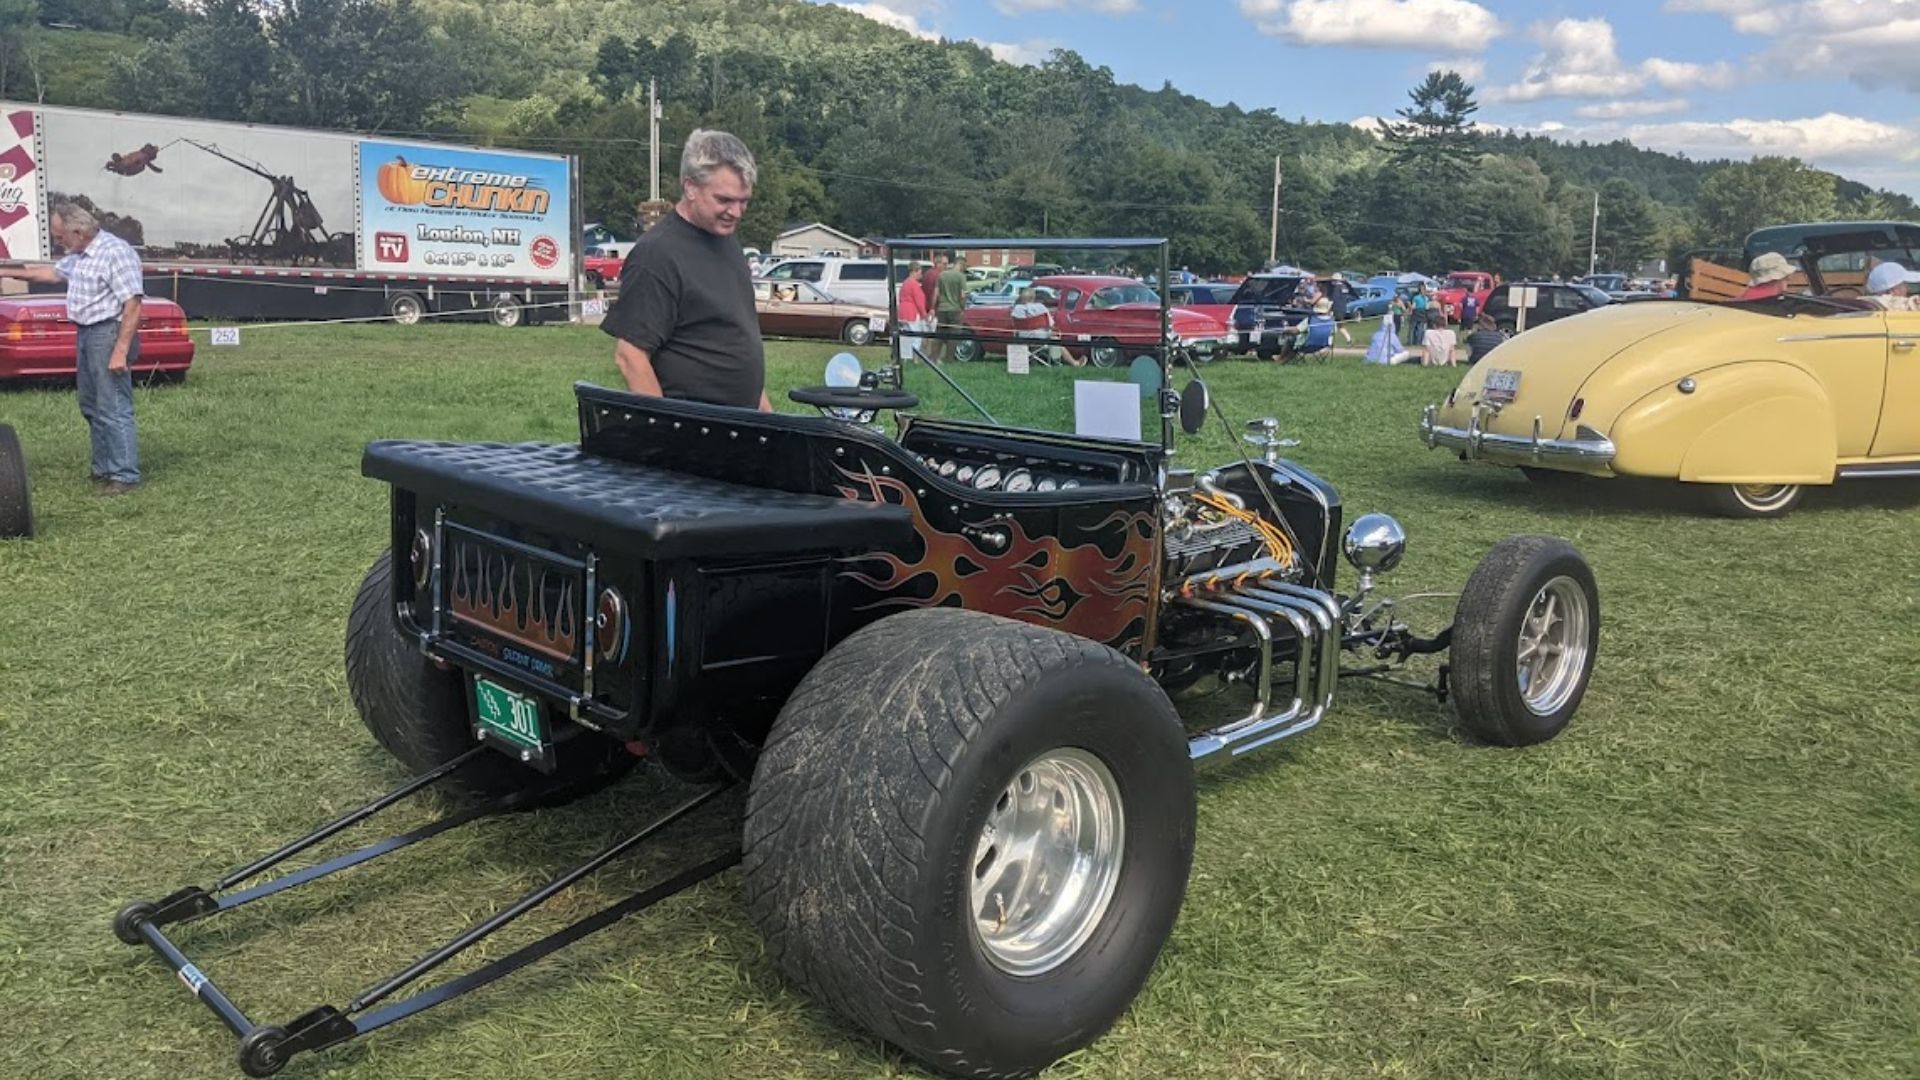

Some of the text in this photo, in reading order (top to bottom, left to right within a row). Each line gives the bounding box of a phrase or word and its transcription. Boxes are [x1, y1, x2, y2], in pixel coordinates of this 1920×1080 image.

[410, 166, 529, 188] extreme
[424, 181, 550, 214] CHUNKIN
[416, 223, 521, 247] Loudon, NH
[379, 243, 403, 258] TV
[424, 251, 449, 265] Oct
[215, 328, 236, 343] 252
